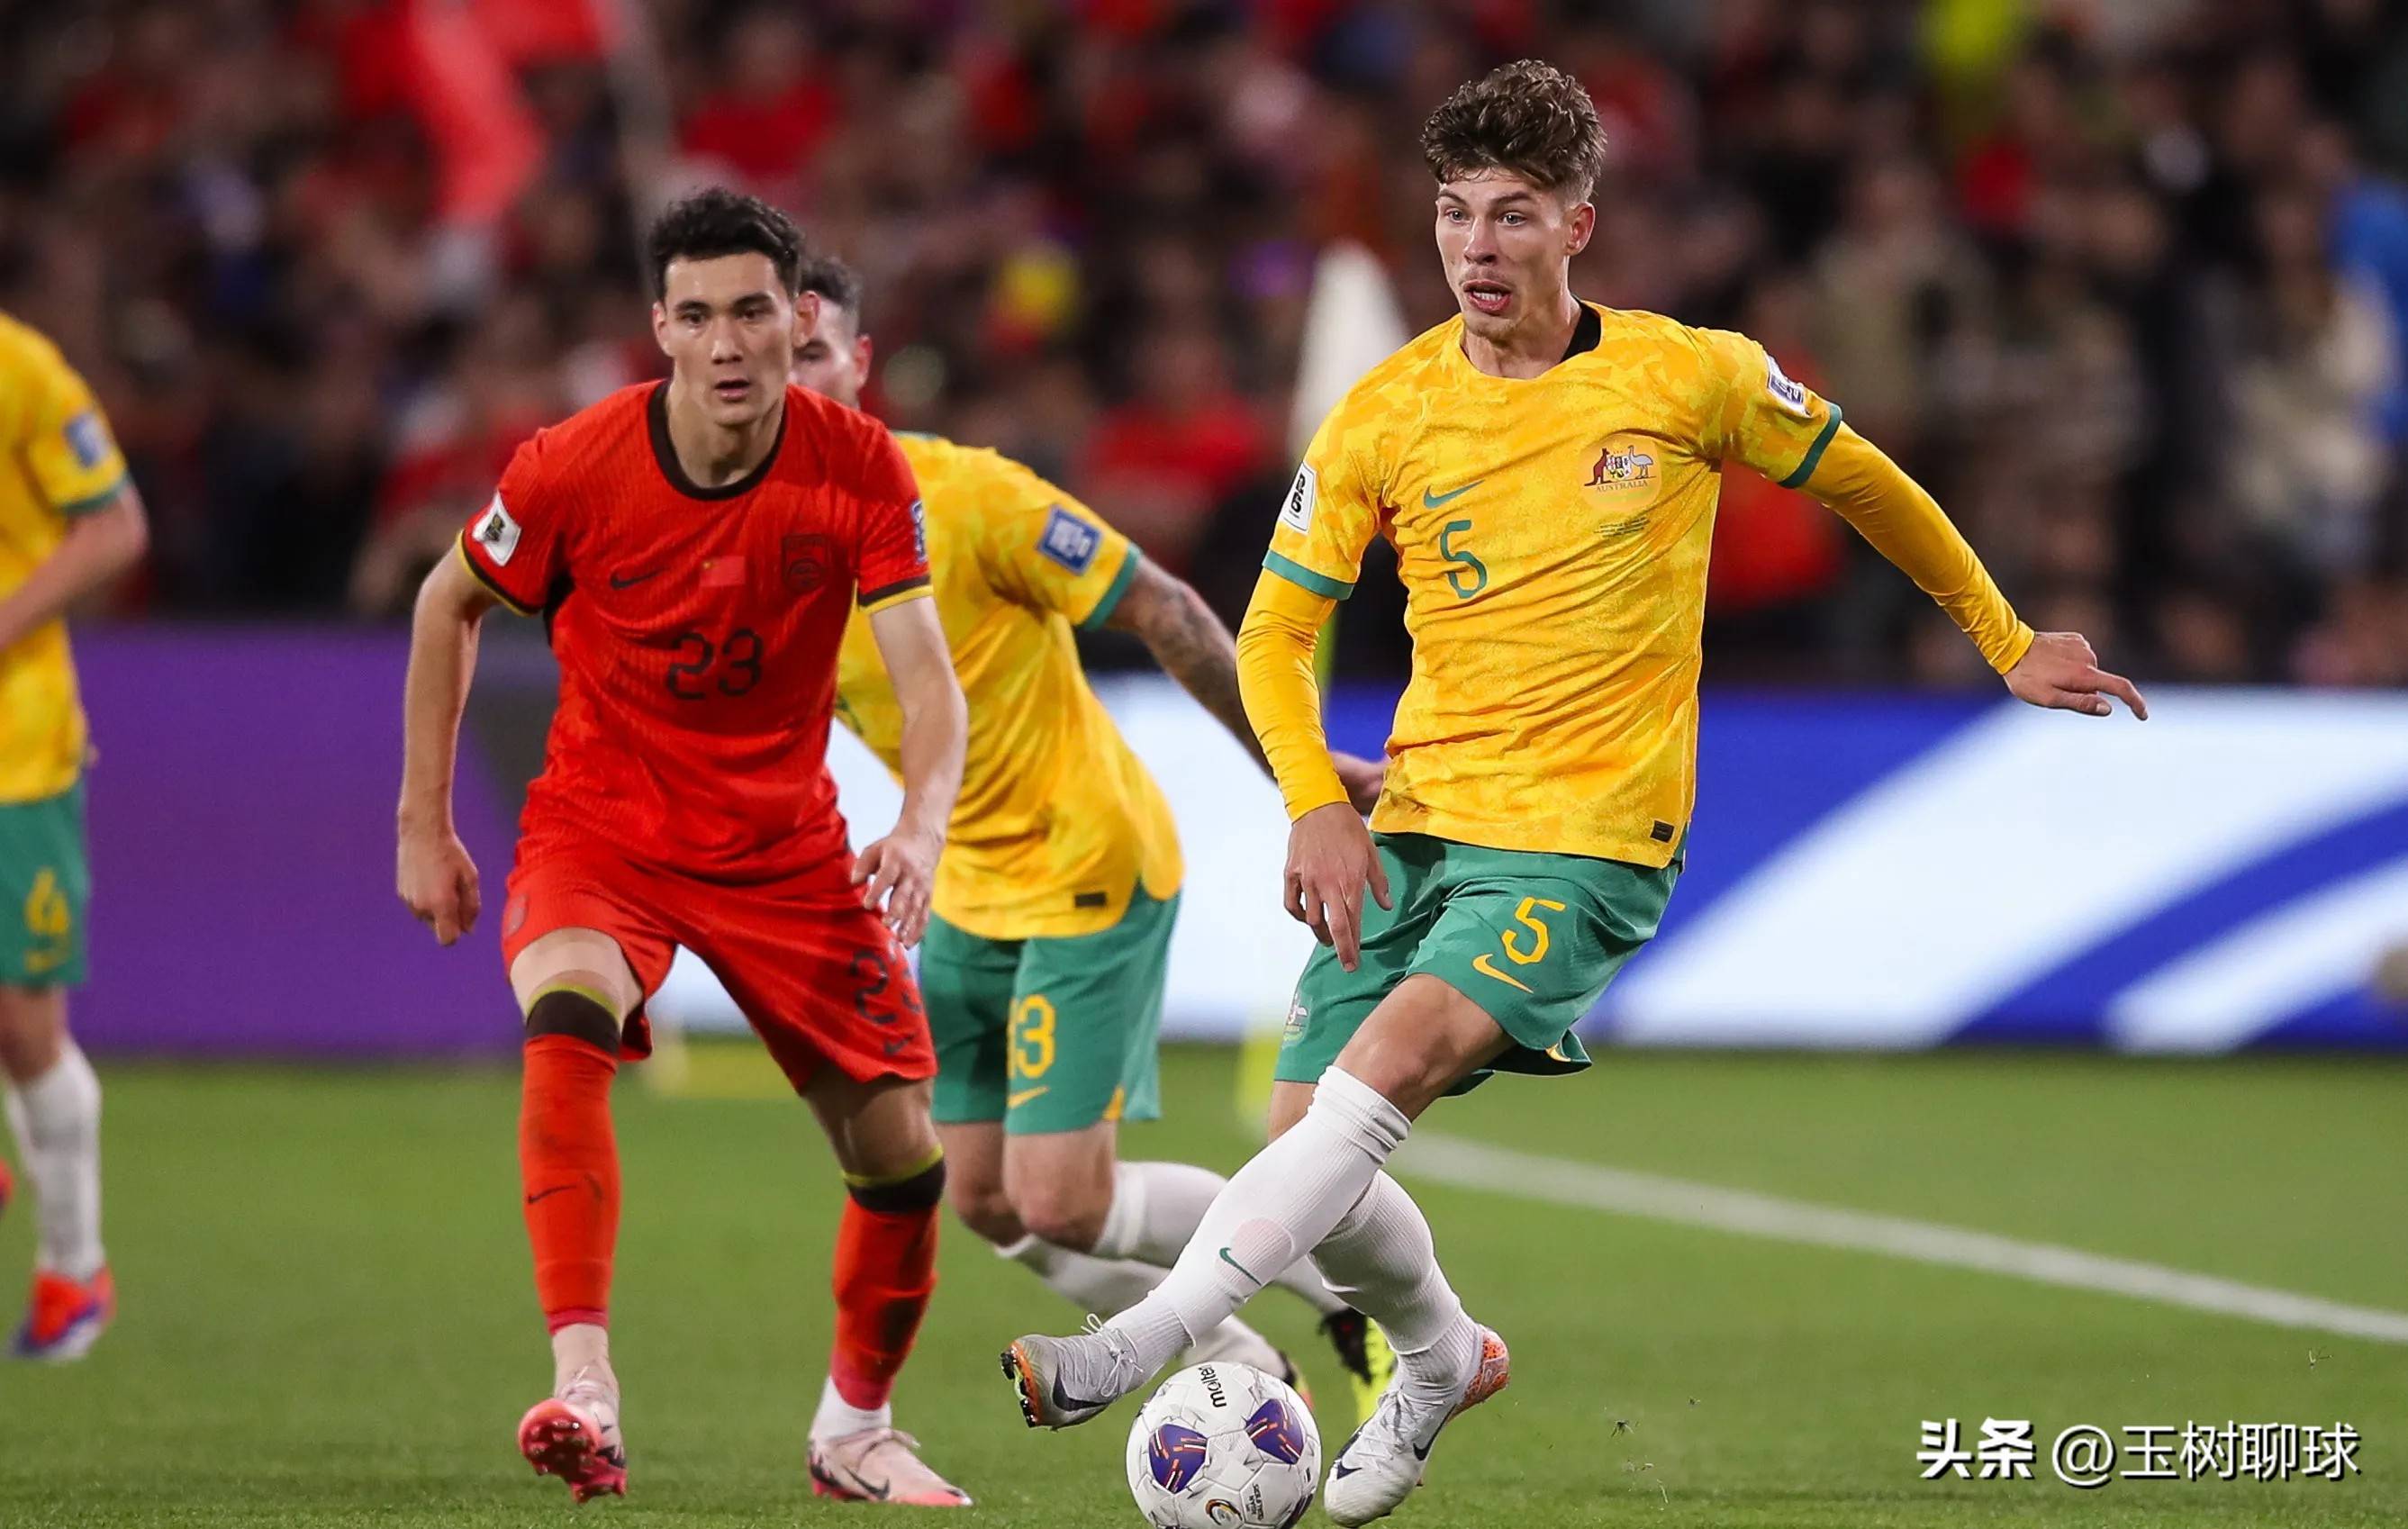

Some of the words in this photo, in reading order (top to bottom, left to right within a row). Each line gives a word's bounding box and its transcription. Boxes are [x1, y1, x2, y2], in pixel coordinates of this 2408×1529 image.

[1596, 480, 1649, 493] AUSTRALIA
[1440, 519, 1488, 600] 5
[665, 629, 764, 700] 23
[1501, 897, 1566, 965] 5
